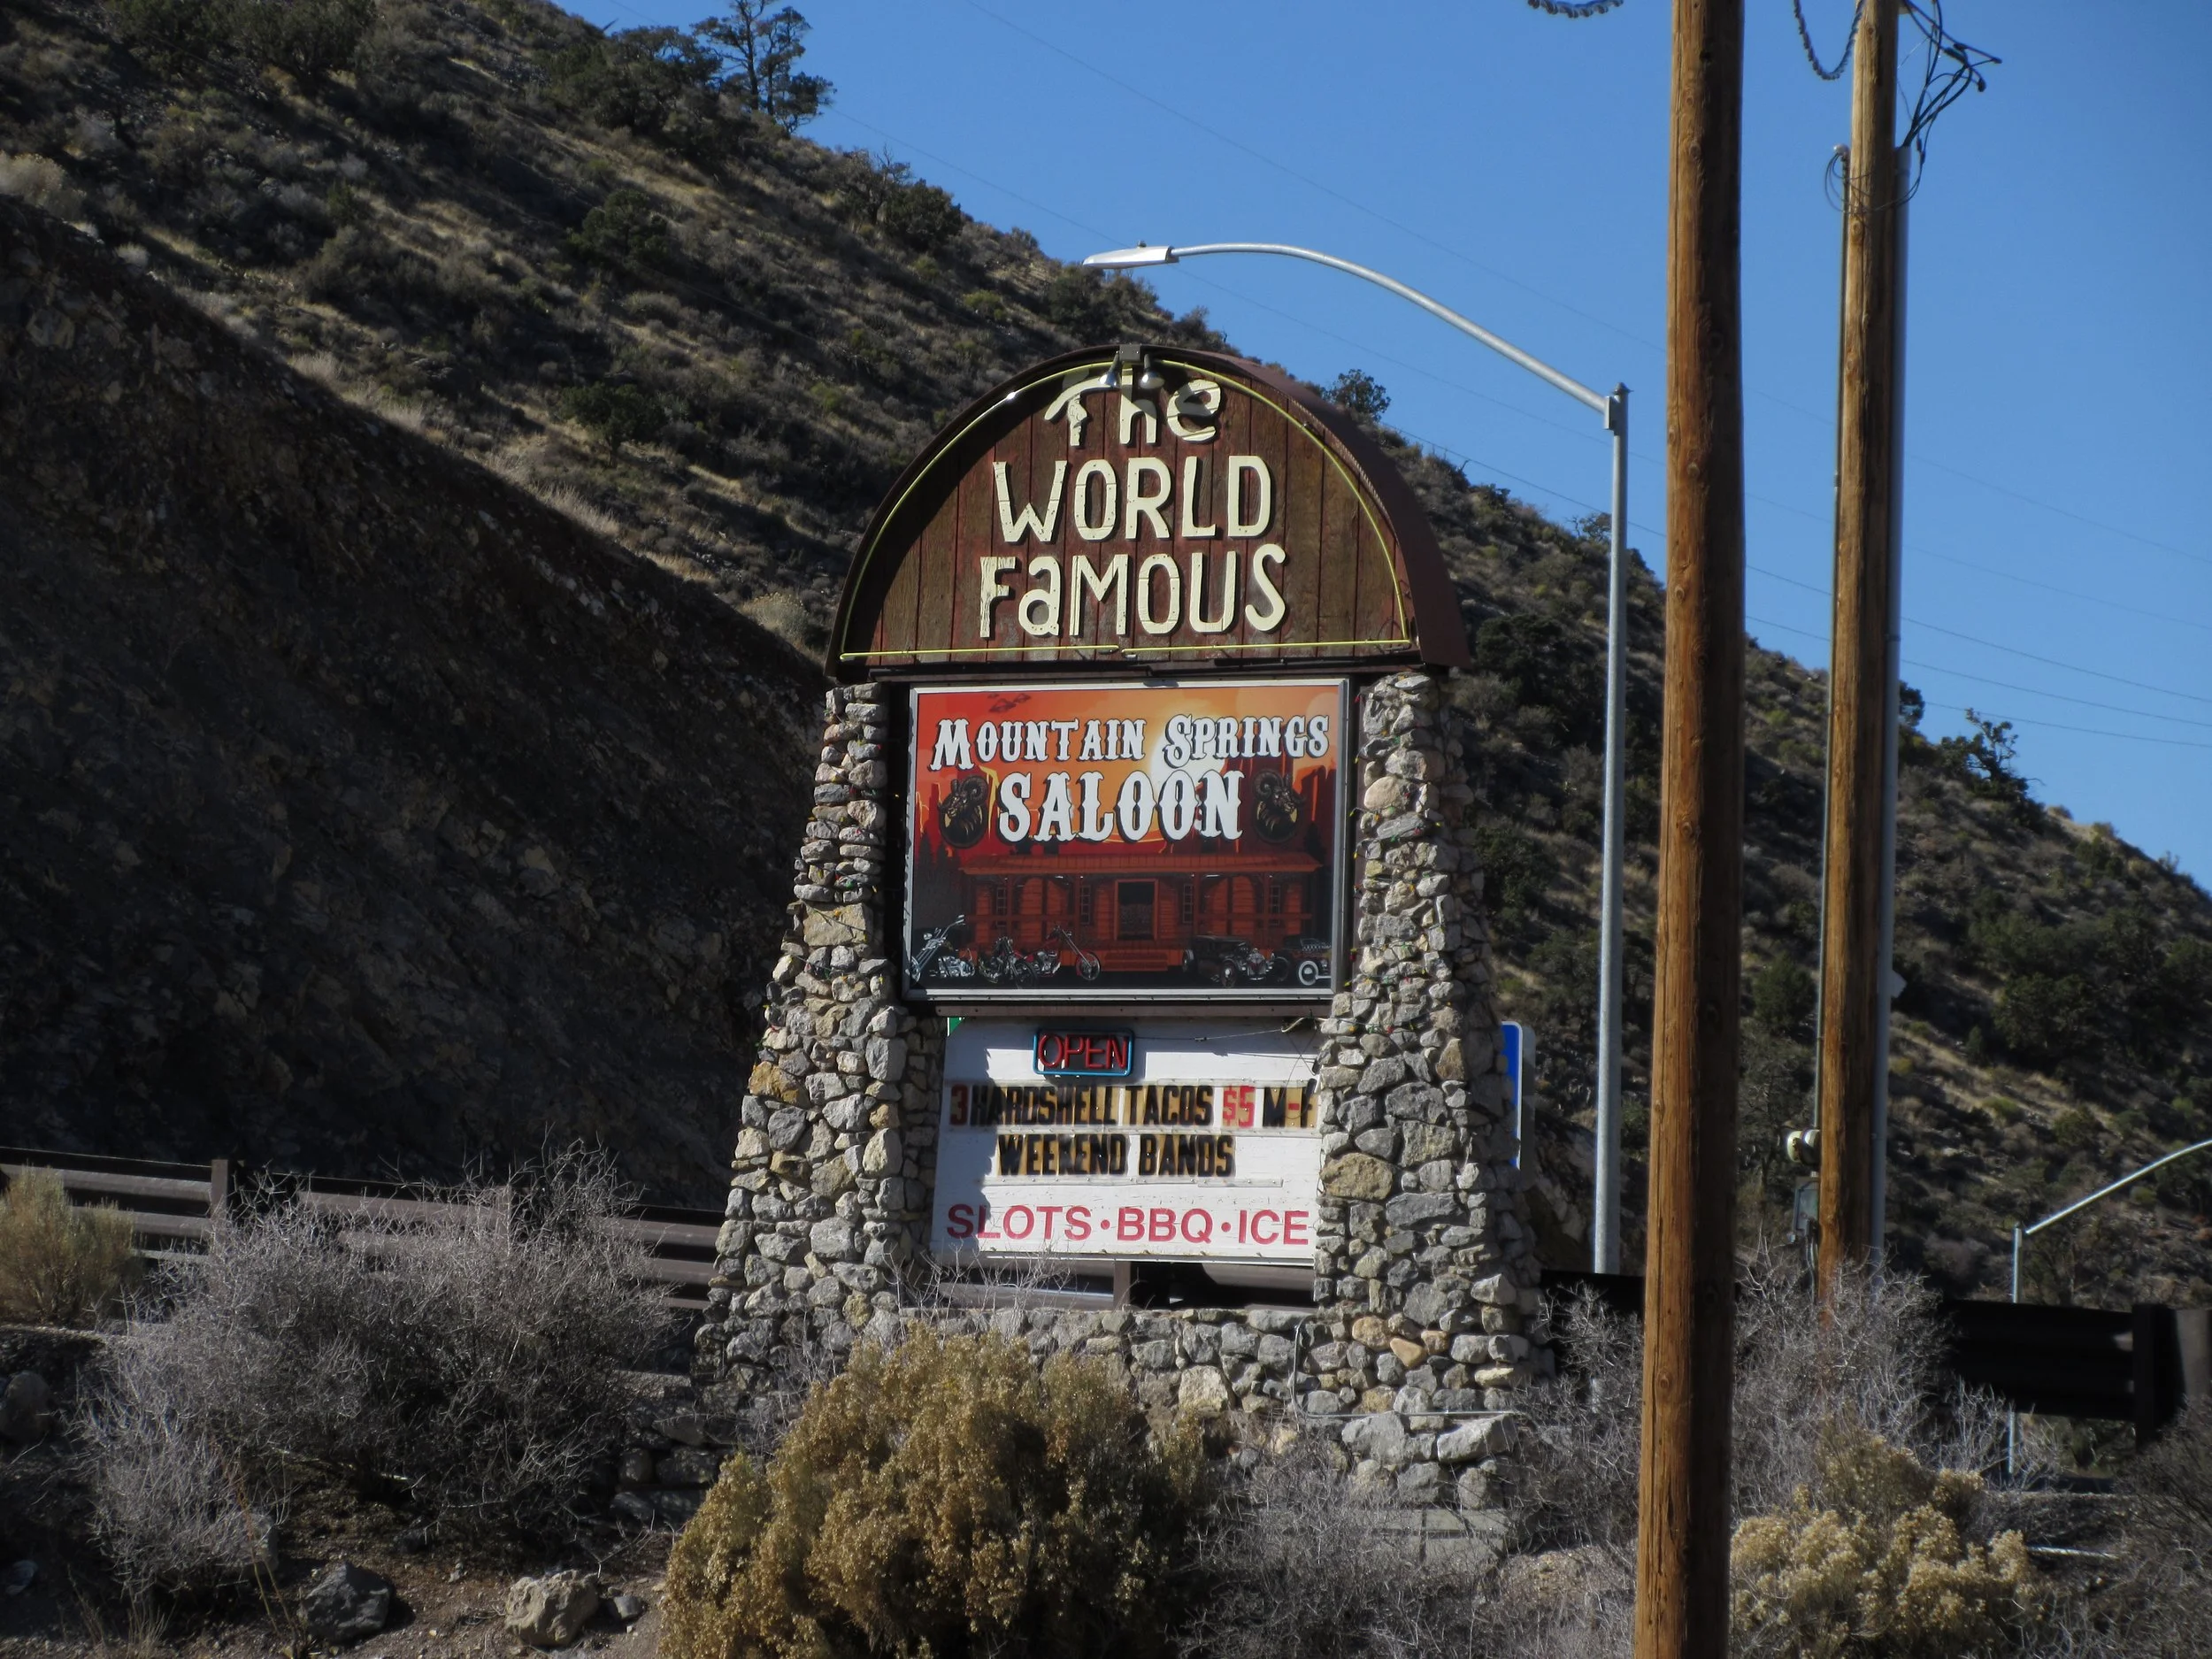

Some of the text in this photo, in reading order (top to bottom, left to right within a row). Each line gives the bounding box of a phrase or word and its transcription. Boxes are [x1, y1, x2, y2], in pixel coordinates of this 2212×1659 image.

[1044, 365, 1222, 447] The
[993, 455, 1272, 542] WORLD
[929, 714, 1330, 772] MOUNTAIN SPRINGS
[996, 769, 1244, 843] SALOON
[1037, 1033, 1129, 1071] OPEN
[950, 1085, 968, 1126] 3
[970, 1085, 1118, 1126] HARDSHELL
[1125, 1085, 1214, 1126] TACOS
[1222, 1085, 1256, 1128] $5
[998, 1133, 1235, 1177] WEEKEND BANDS
[947, 1204, 1310, 1246] SLOTS BBQ ICE
